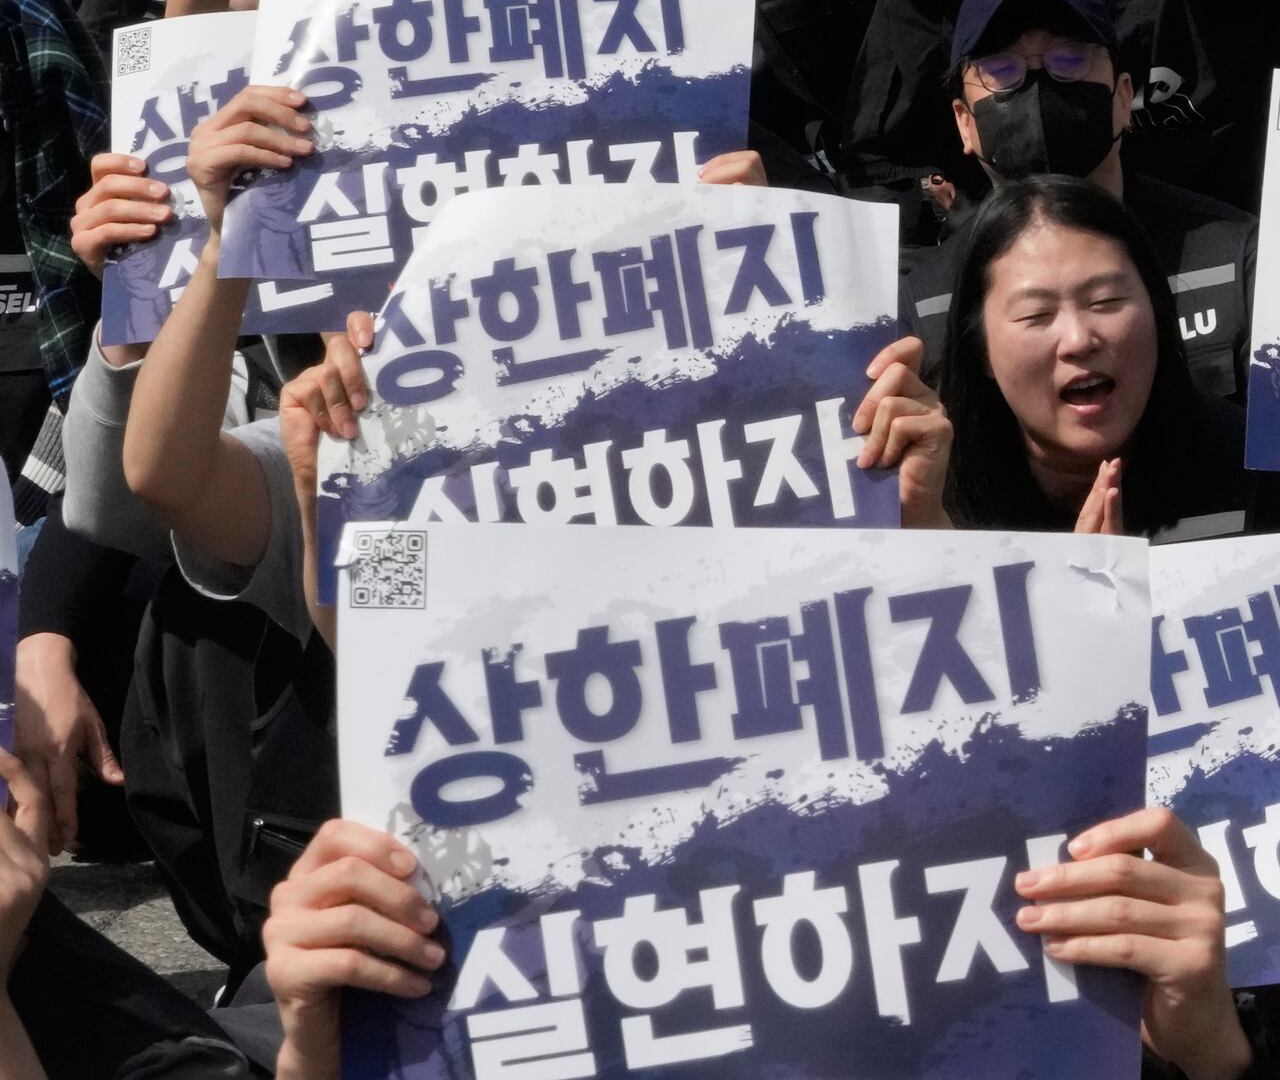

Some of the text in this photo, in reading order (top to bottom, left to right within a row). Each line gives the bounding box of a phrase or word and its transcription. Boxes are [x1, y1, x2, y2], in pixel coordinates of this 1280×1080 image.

[0, 291, 40, 315] SEL
[373, 212, 825, 405] 상한폐지
[1176, 308, 1219, 342] LU
[384, 560, 1040, 826] 상한폐지
[450, 834, 1080, 1080] 실현하자
